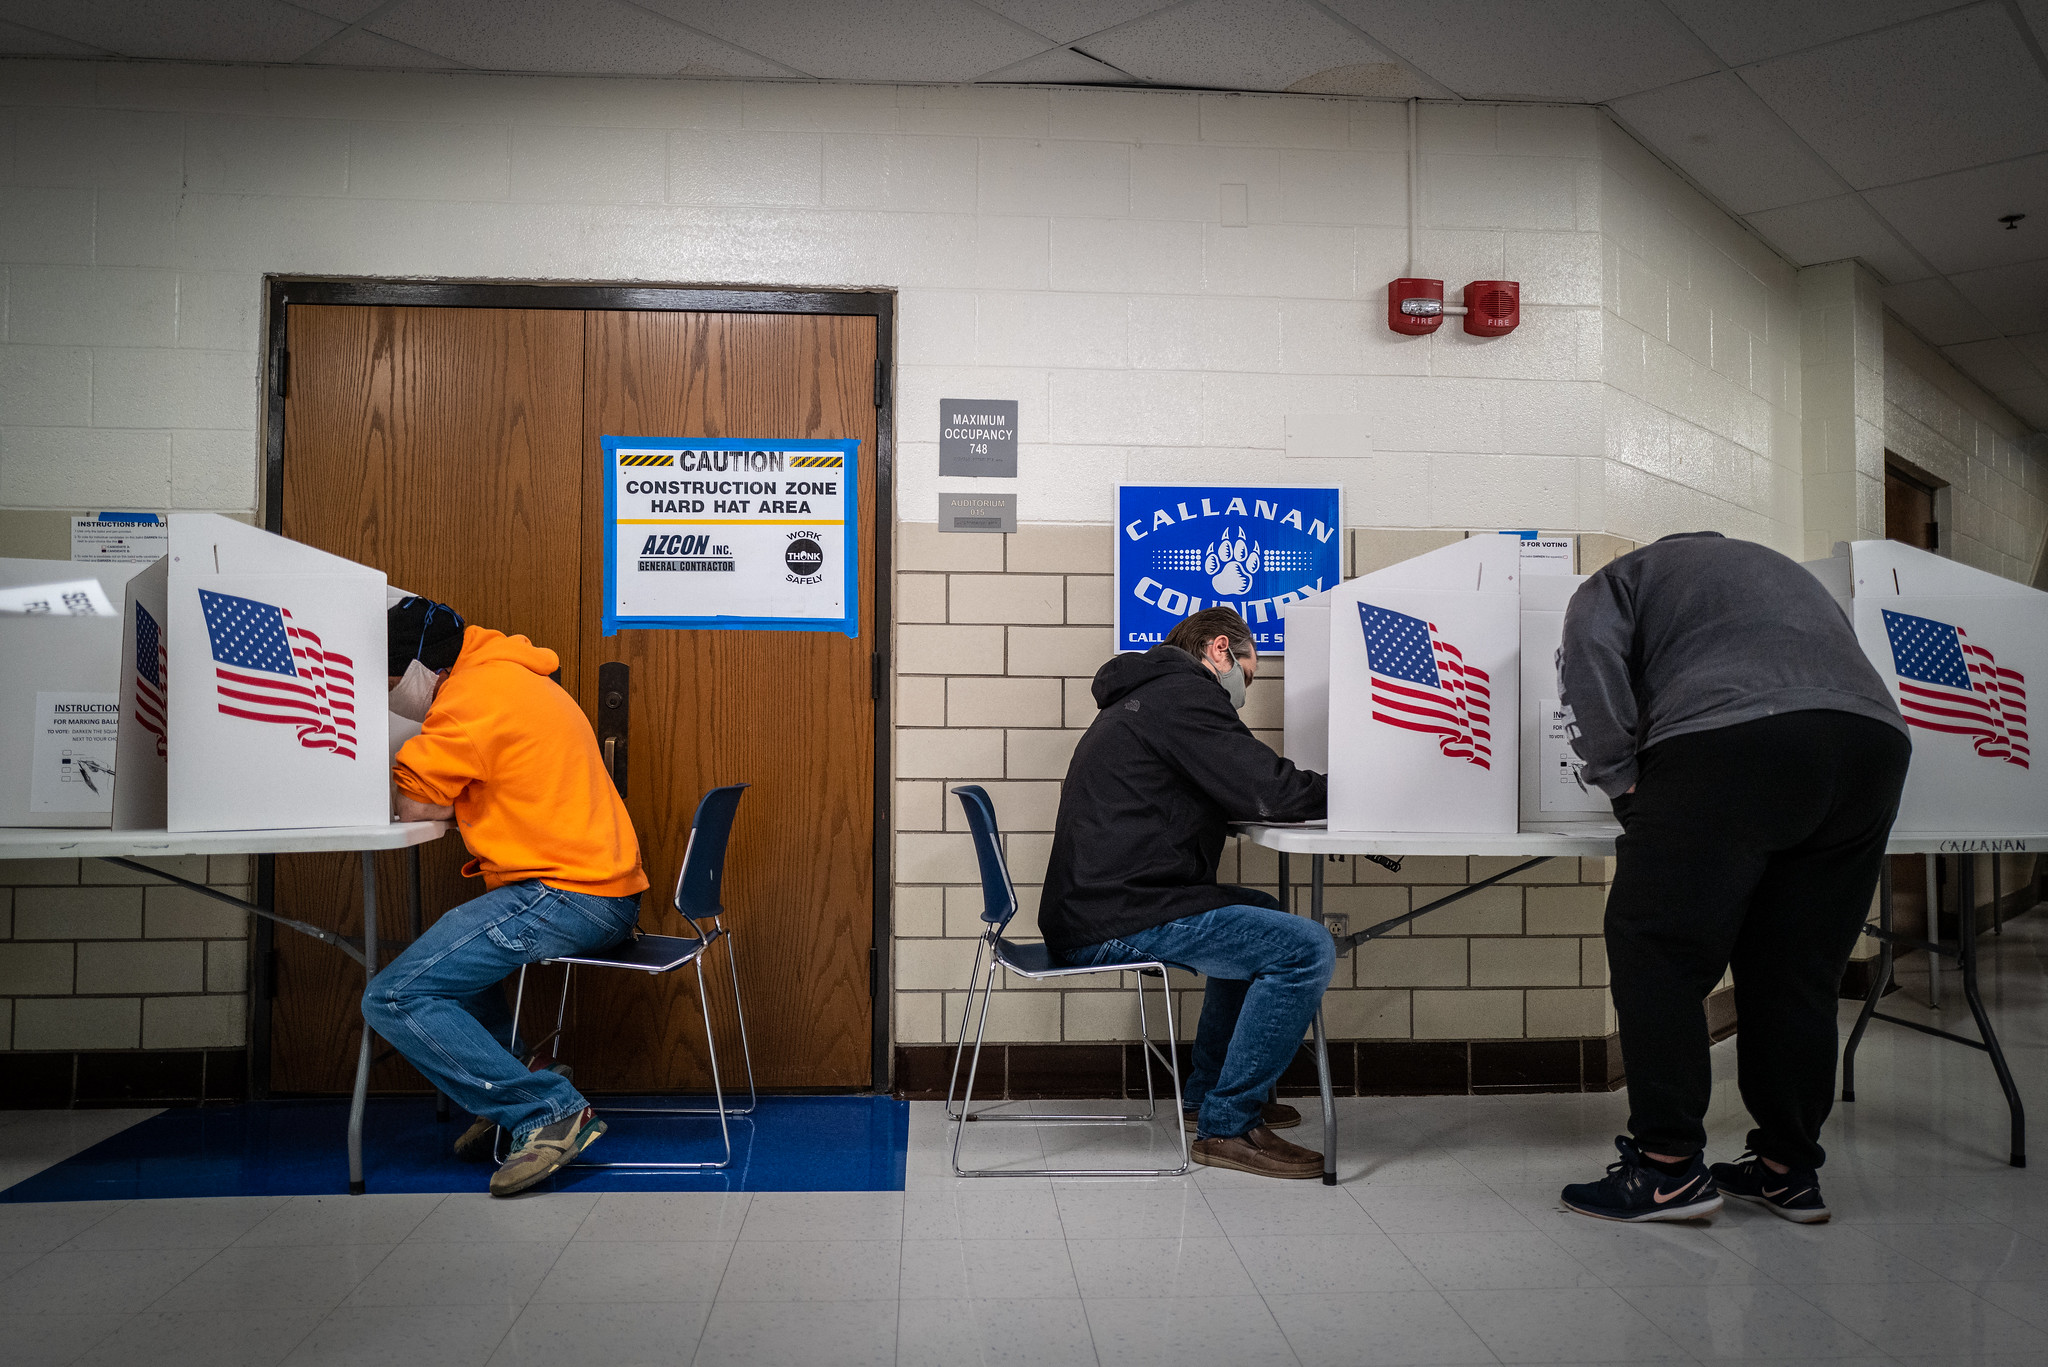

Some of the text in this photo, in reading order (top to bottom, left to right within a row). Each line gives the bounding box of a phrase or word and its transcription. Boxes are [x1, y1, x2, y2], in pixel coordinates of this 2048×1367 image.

[1411, 317, 1433, 325] FIRE
[953, 414, 1005, 426] MAXIMUM
[944, 428, 1013, 440] OCCUPANCY
[970, 443, 988, 454] 748
[680, 450, 784, 472] CAUTION
[626, 481, 837, 495] CONSTRUCTION ZONE
[651, 500, 811, 513] HARD HAT AREA
[951, 499, 1005, 507] AUDITORIUM
[1125, 497, 1335, 544] CALLANAN
[786, 530, 822, 541] WORK
[641, 535, 733, 555] AZCON INC.
[639, 561, 734, 572] GENERAL CONTRACTOR
[785, 574, 823, 585] SAFELY
[1129, 632, 1164, 643] CALL
[55, 704, 119, 712] INSTRUCTION
[1940, 839, 2026, 852] CALLANAN
